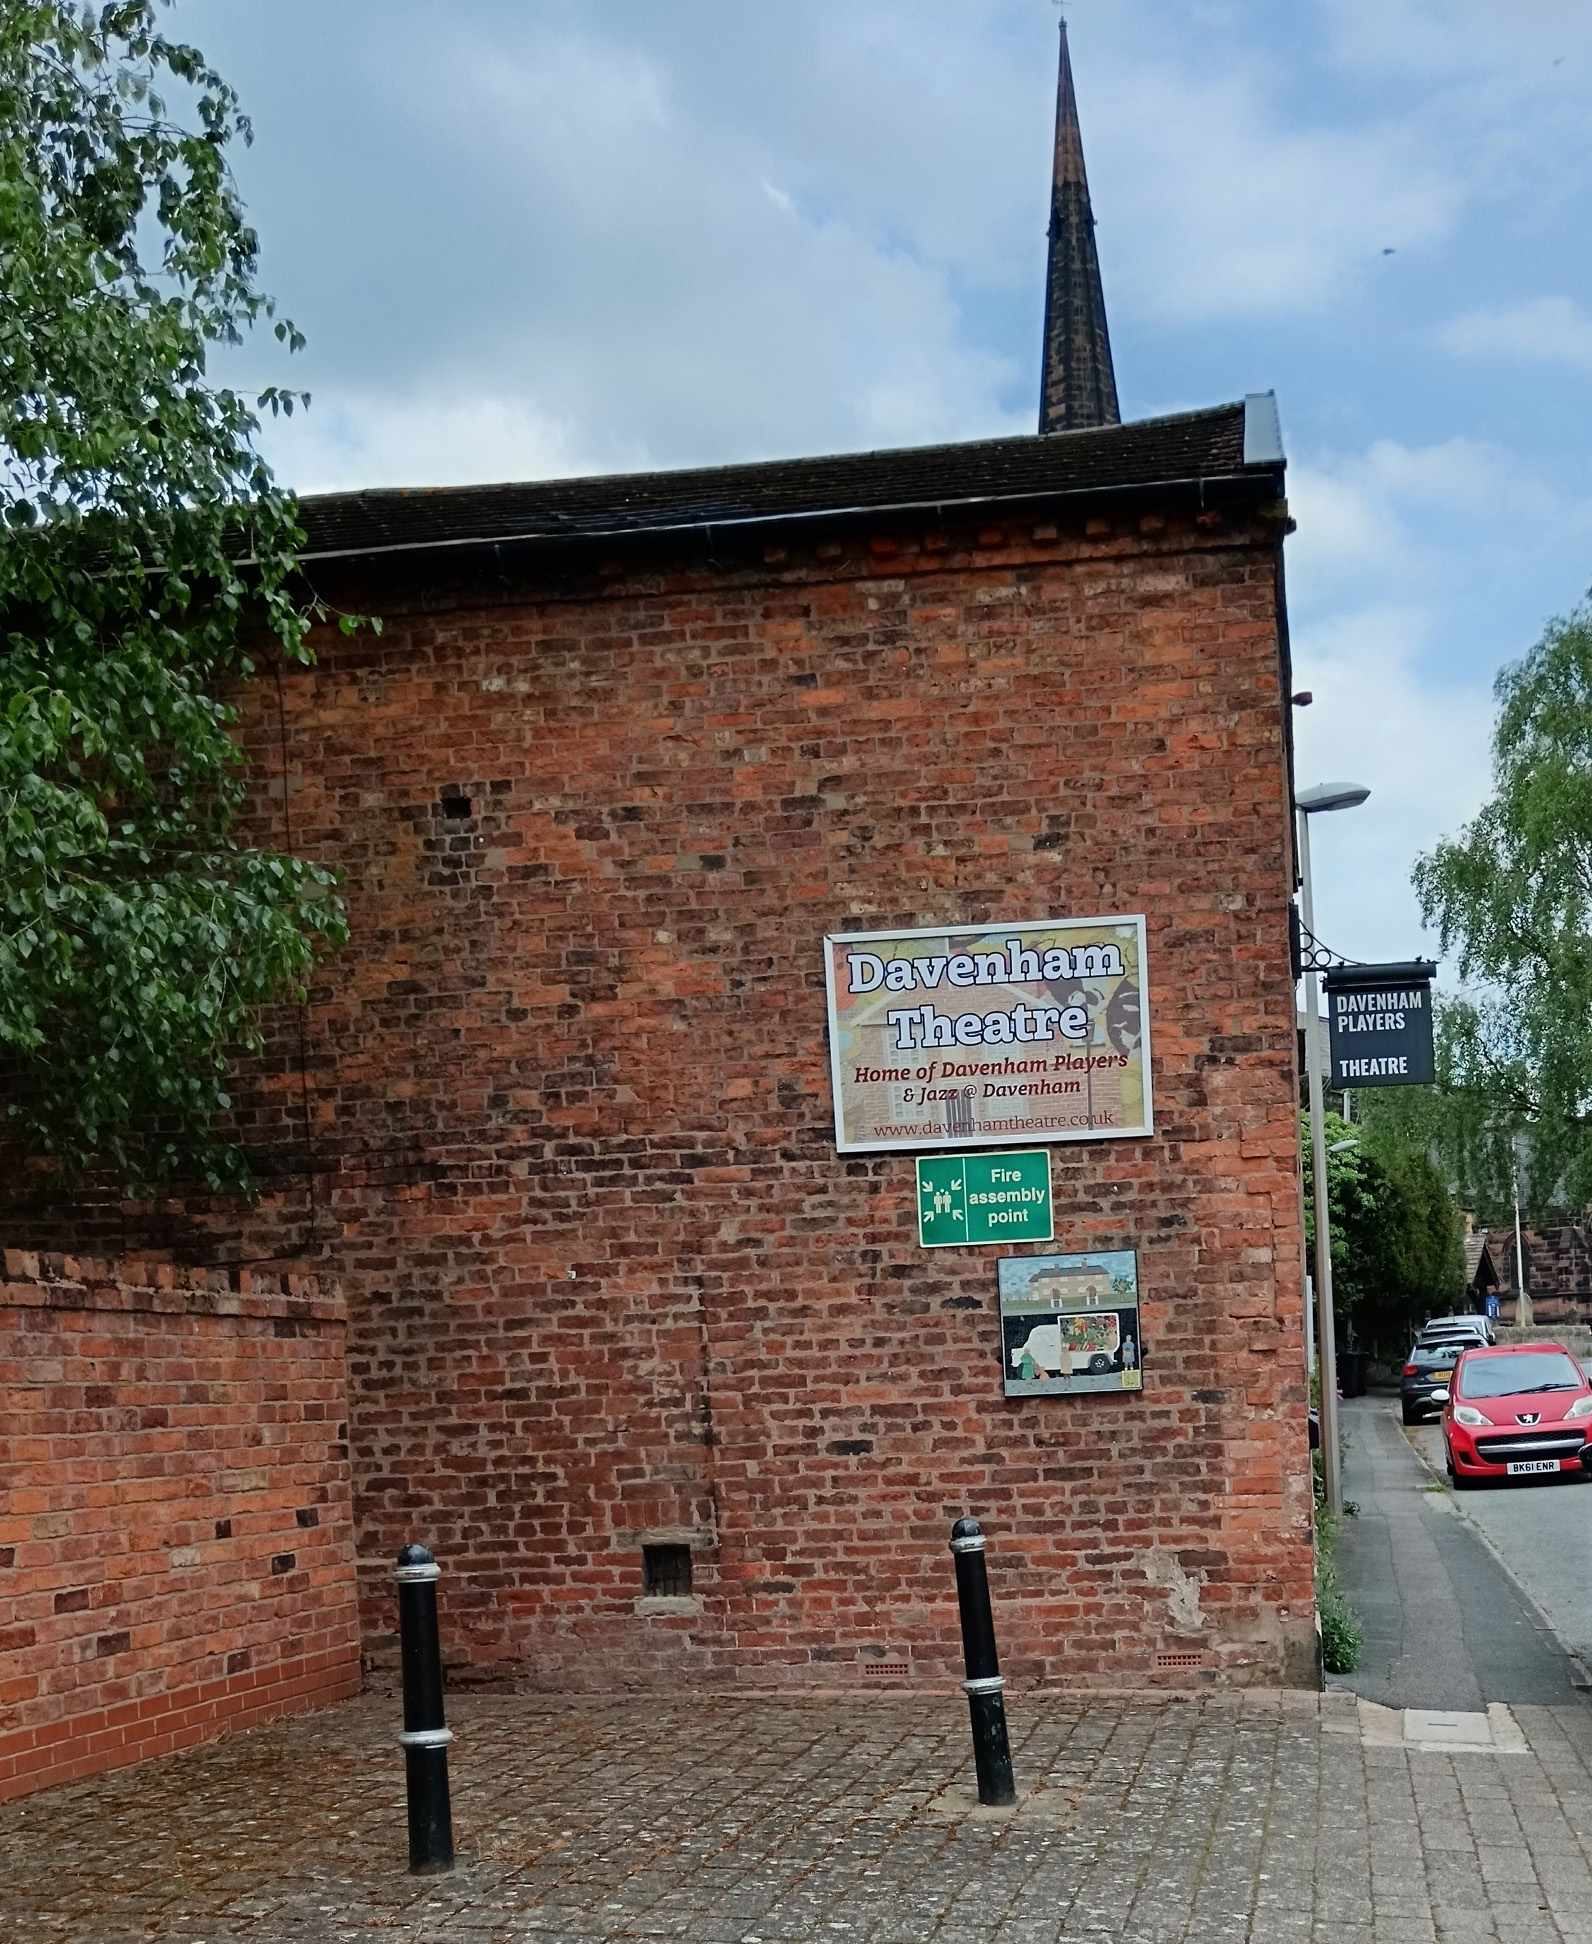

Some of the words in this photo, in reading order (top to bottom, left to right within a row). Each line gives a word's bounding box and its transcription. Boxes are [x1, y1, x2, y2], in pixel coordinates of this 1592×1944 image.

[848, 939, 1124, 993] Davenham
[1336, 991, 1422, 1012] DAVENHAM
[888, 1003, 1088, 1049] Theatre
[1338, 1012, 1406, 1033] PLAYERS
[854, 1067, 910, 1083] Home
[916, 1061, 938, 1084] of
[941, 1057, 1047, 1078] Davenham
[1053, 1052, 1129, 1074] Players
[1340, 1056, 1408, 1077] THEATRE
[903, 1088, 914, 1103] &
[916, 1087, 959, 1106] Jazz
[963, 1084, 977, 1099] @
[982, 1079, 1081, 1099] Davenham
[874, 1110, 1113, 1137] www.davenhamtheatre.couk
[991, 1168, 1022, 1183] Fire
[969, 1187, 1045, 1205] assembly
[988, 1208, 1029, 1228] point
[1513, 1463, 1534, 1472] BK61
[1536, 1461, 1555, 1471] ENR
